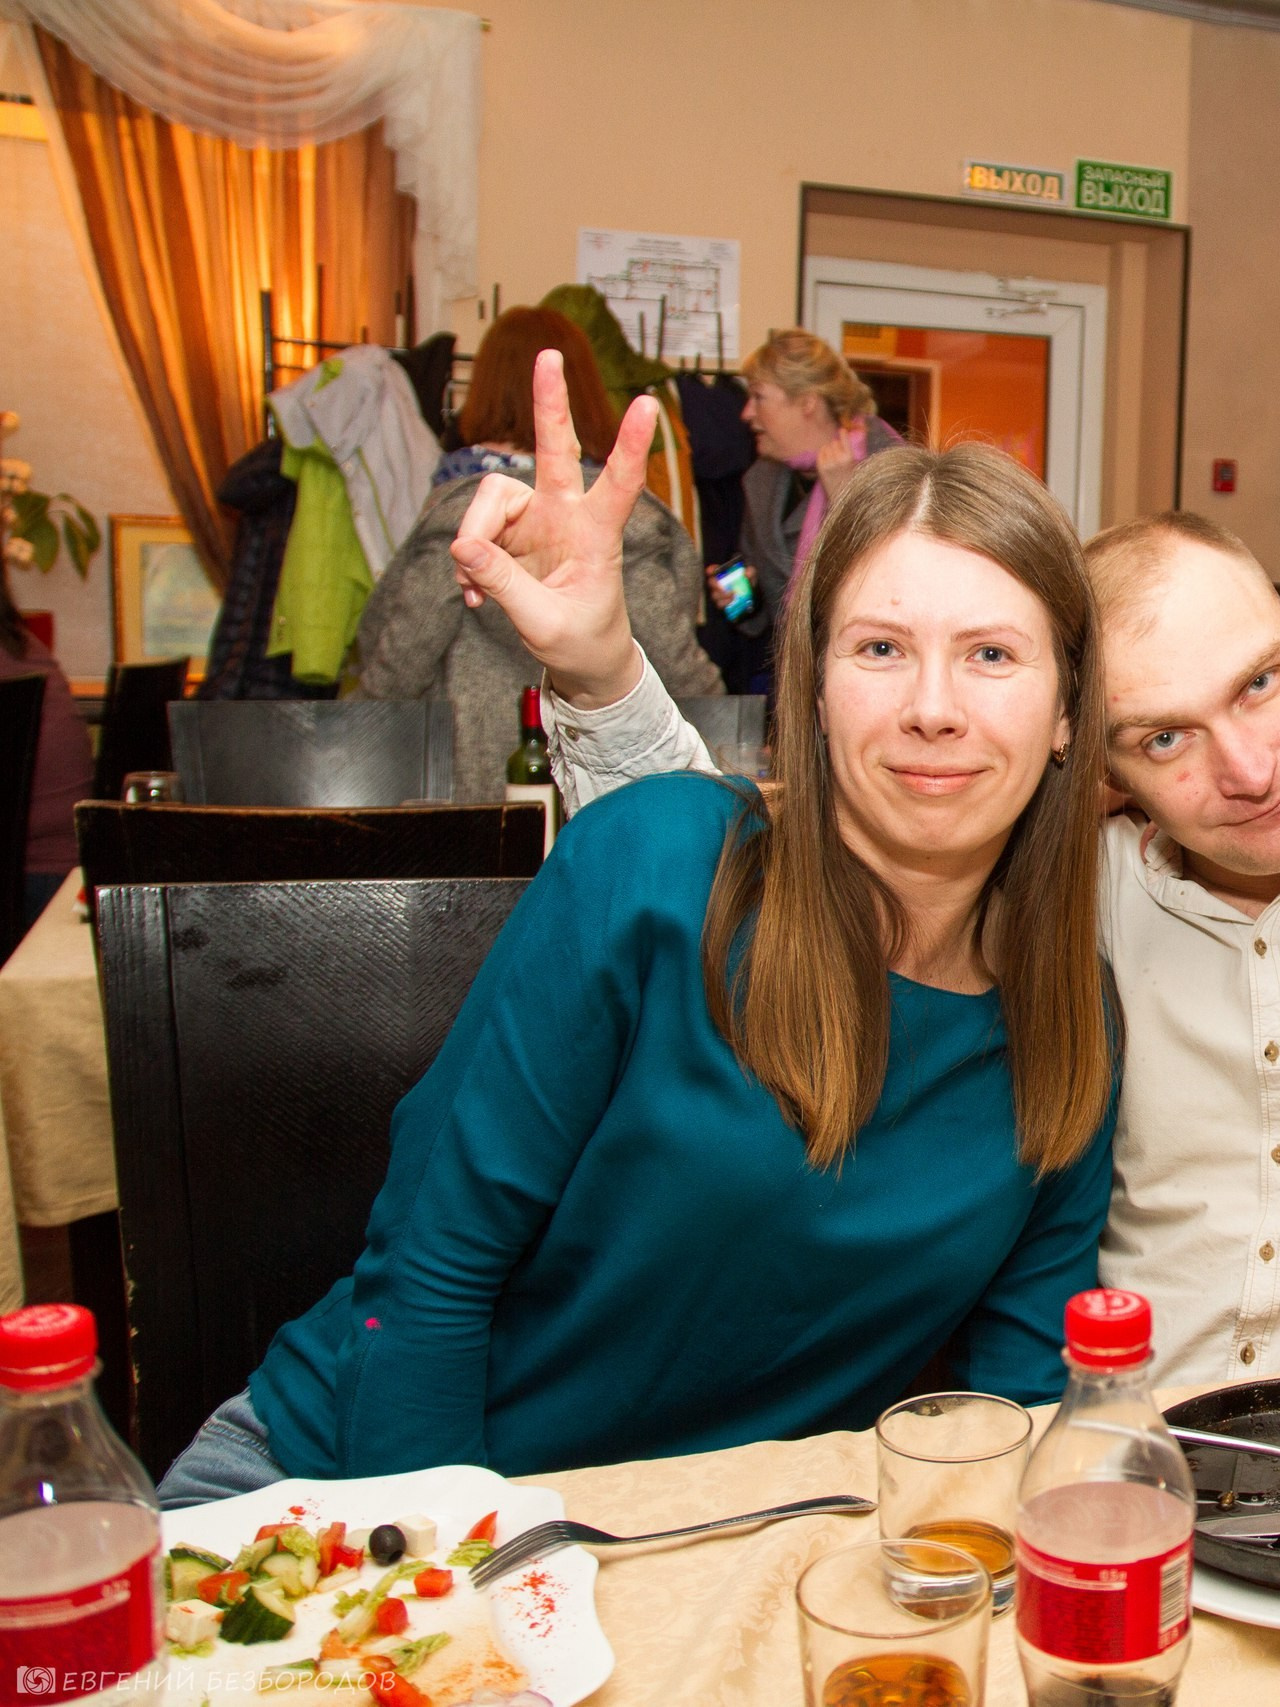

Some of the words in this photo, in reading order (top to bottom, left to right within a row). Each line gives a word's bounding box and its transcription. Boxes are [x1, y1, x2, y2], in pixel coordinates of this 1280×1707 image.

[971, 165, 1060, 199] ВЫХОД
[1083, 166, 1165, 187] ЗАПАСНЫЙ
[1082, 182, 1165, 213] ВЫХОД
